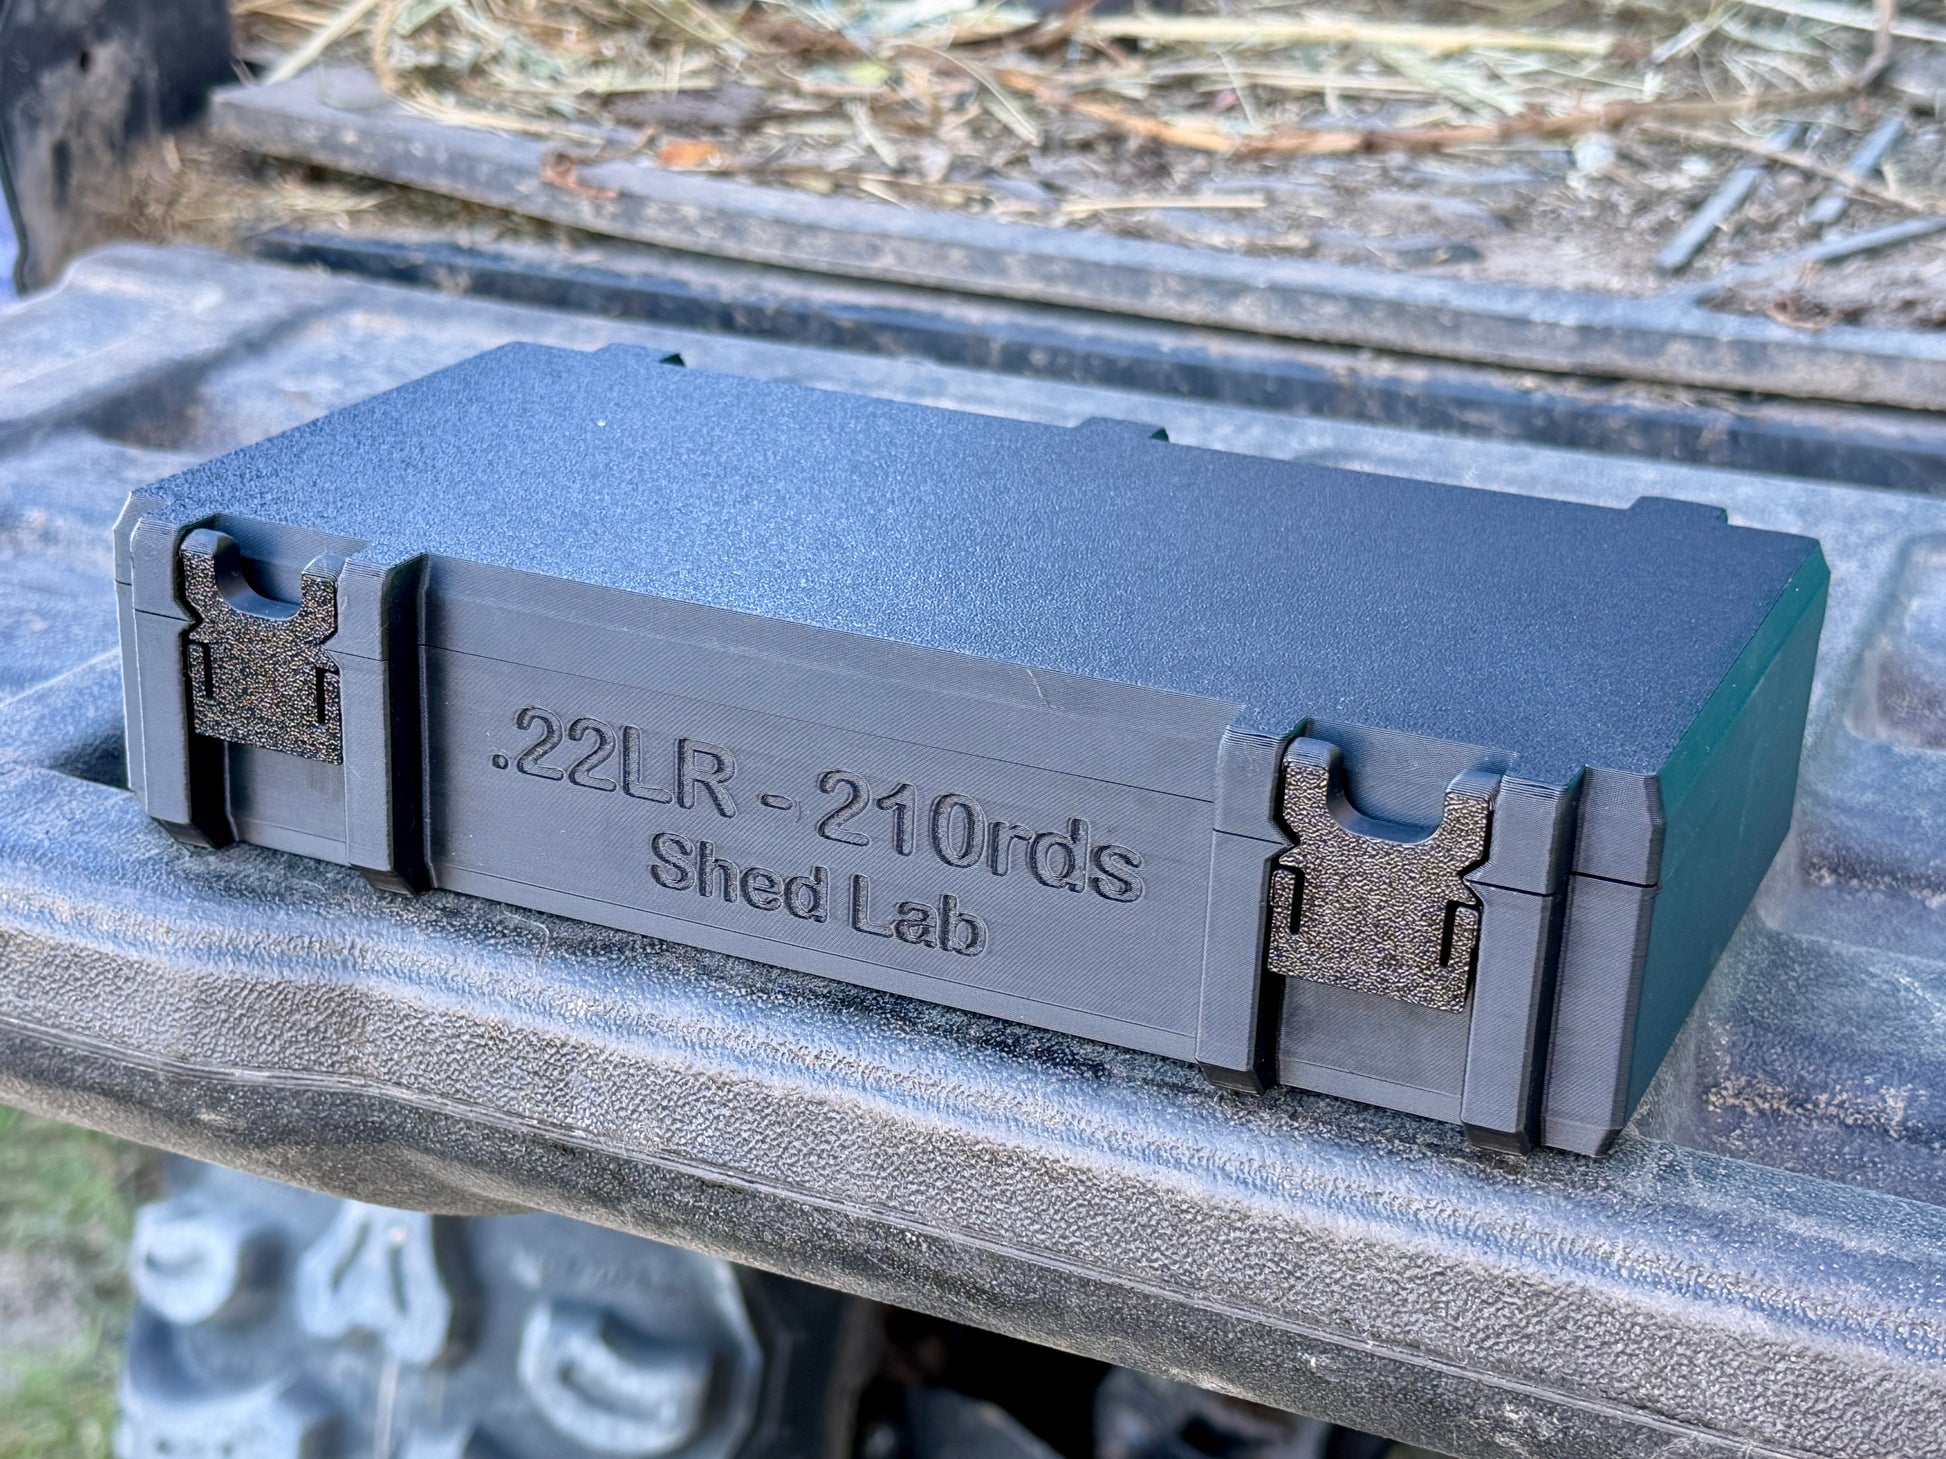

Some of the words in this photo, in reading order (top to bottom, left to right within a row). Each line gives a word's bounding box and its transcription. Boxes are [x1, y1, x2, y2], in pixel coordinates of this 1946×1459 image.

[491, 706, 737, 818] .22LR
[760, 793, 793, 810] -
[816, 769, 1144, 903] 210rds
[651, 832, 829, 923] Shed
[851, 874, 988, 957] Lab
